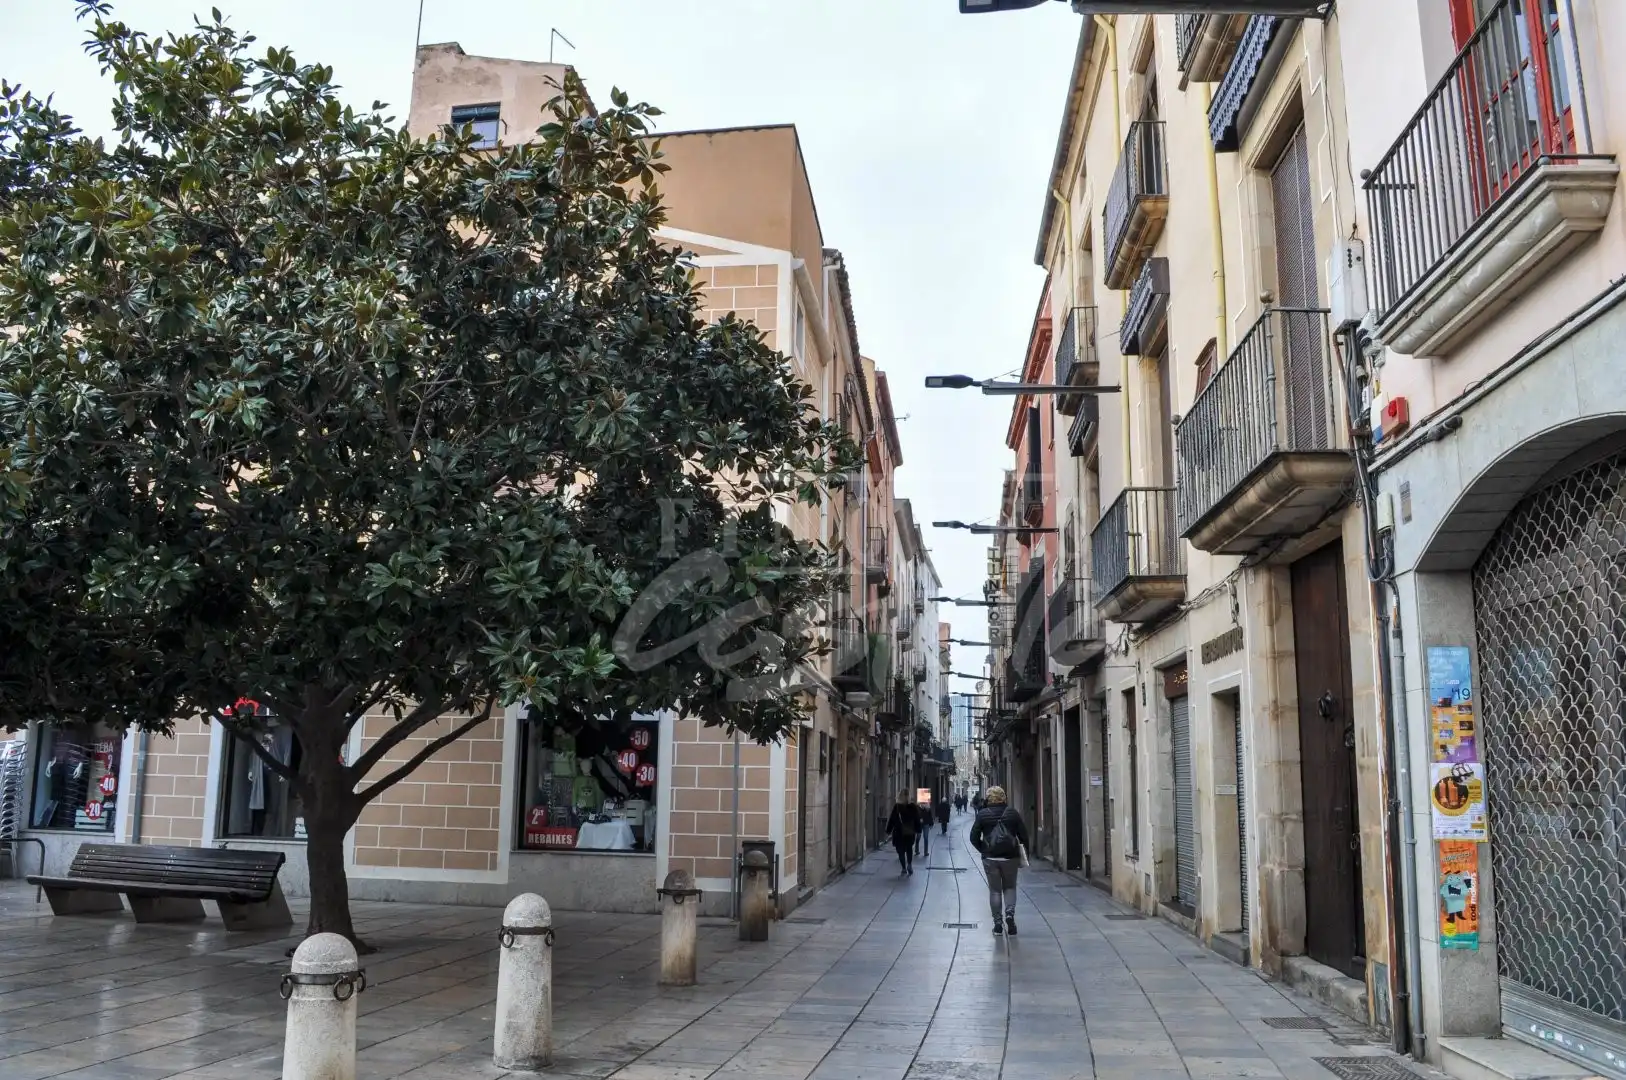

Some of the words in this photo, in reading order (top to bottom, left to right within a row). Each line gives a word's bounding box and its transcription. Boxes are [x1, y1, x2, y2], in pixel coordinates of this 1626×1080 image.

[629, 730, 649, 746] -50
[617, 753, 636, 768] -40
[636, 766, 655, 782] -30
[99, 777, 115, 792] -40
[85, 802, 101, 817] -20
[528, 833, 573, 845] REBAIXES
